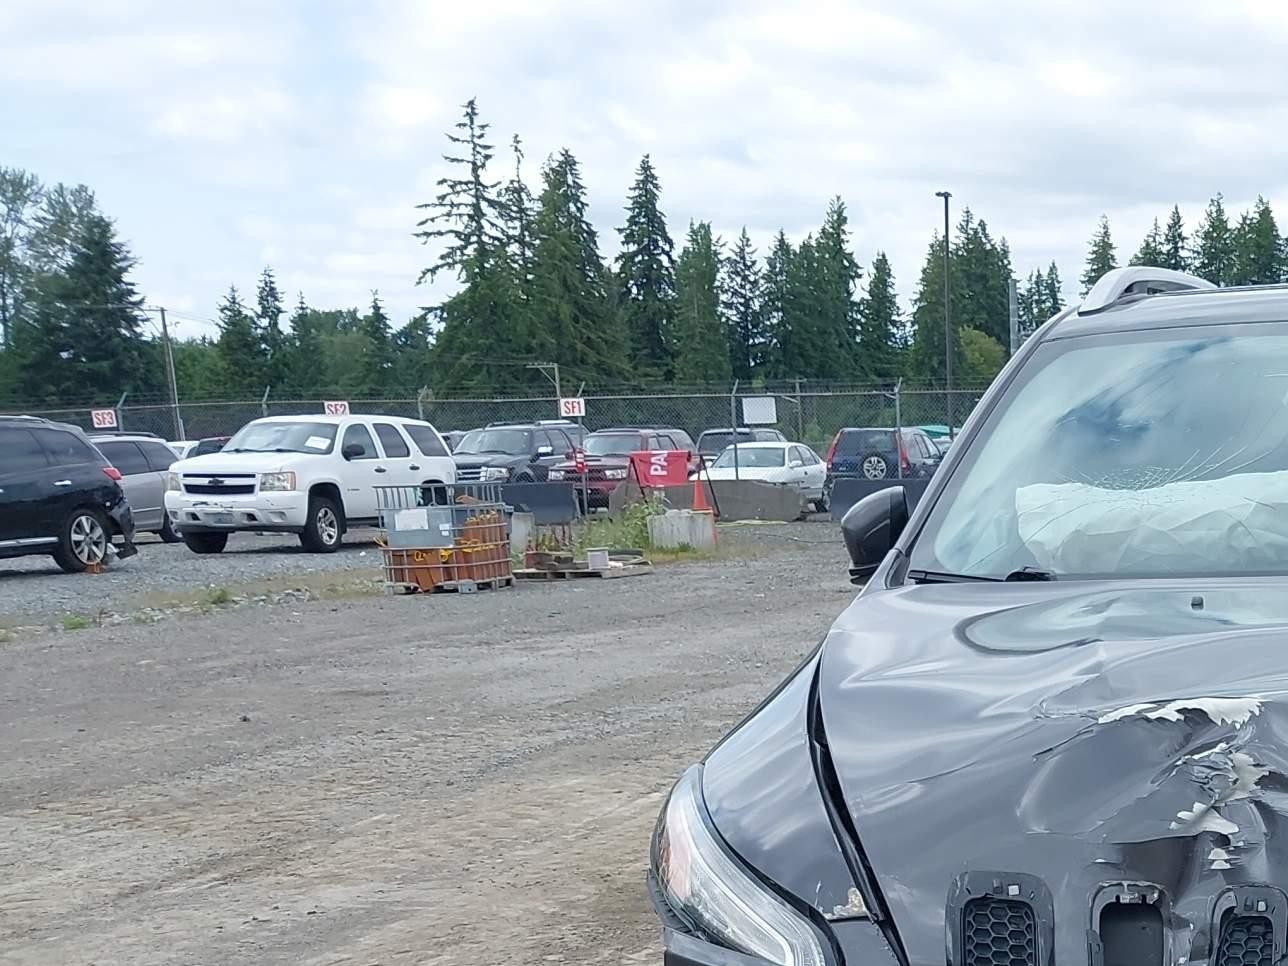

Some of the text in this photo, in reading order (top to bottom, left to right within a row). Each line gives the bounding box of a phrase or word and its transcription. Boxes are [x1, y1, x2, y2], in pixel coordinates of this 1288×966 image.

[327, 404, 346, 415] SF2
[564, 401, 581, 414] SF1
[95, 412, 114, 425] SF3
[650, 450, 668, 476] PA
